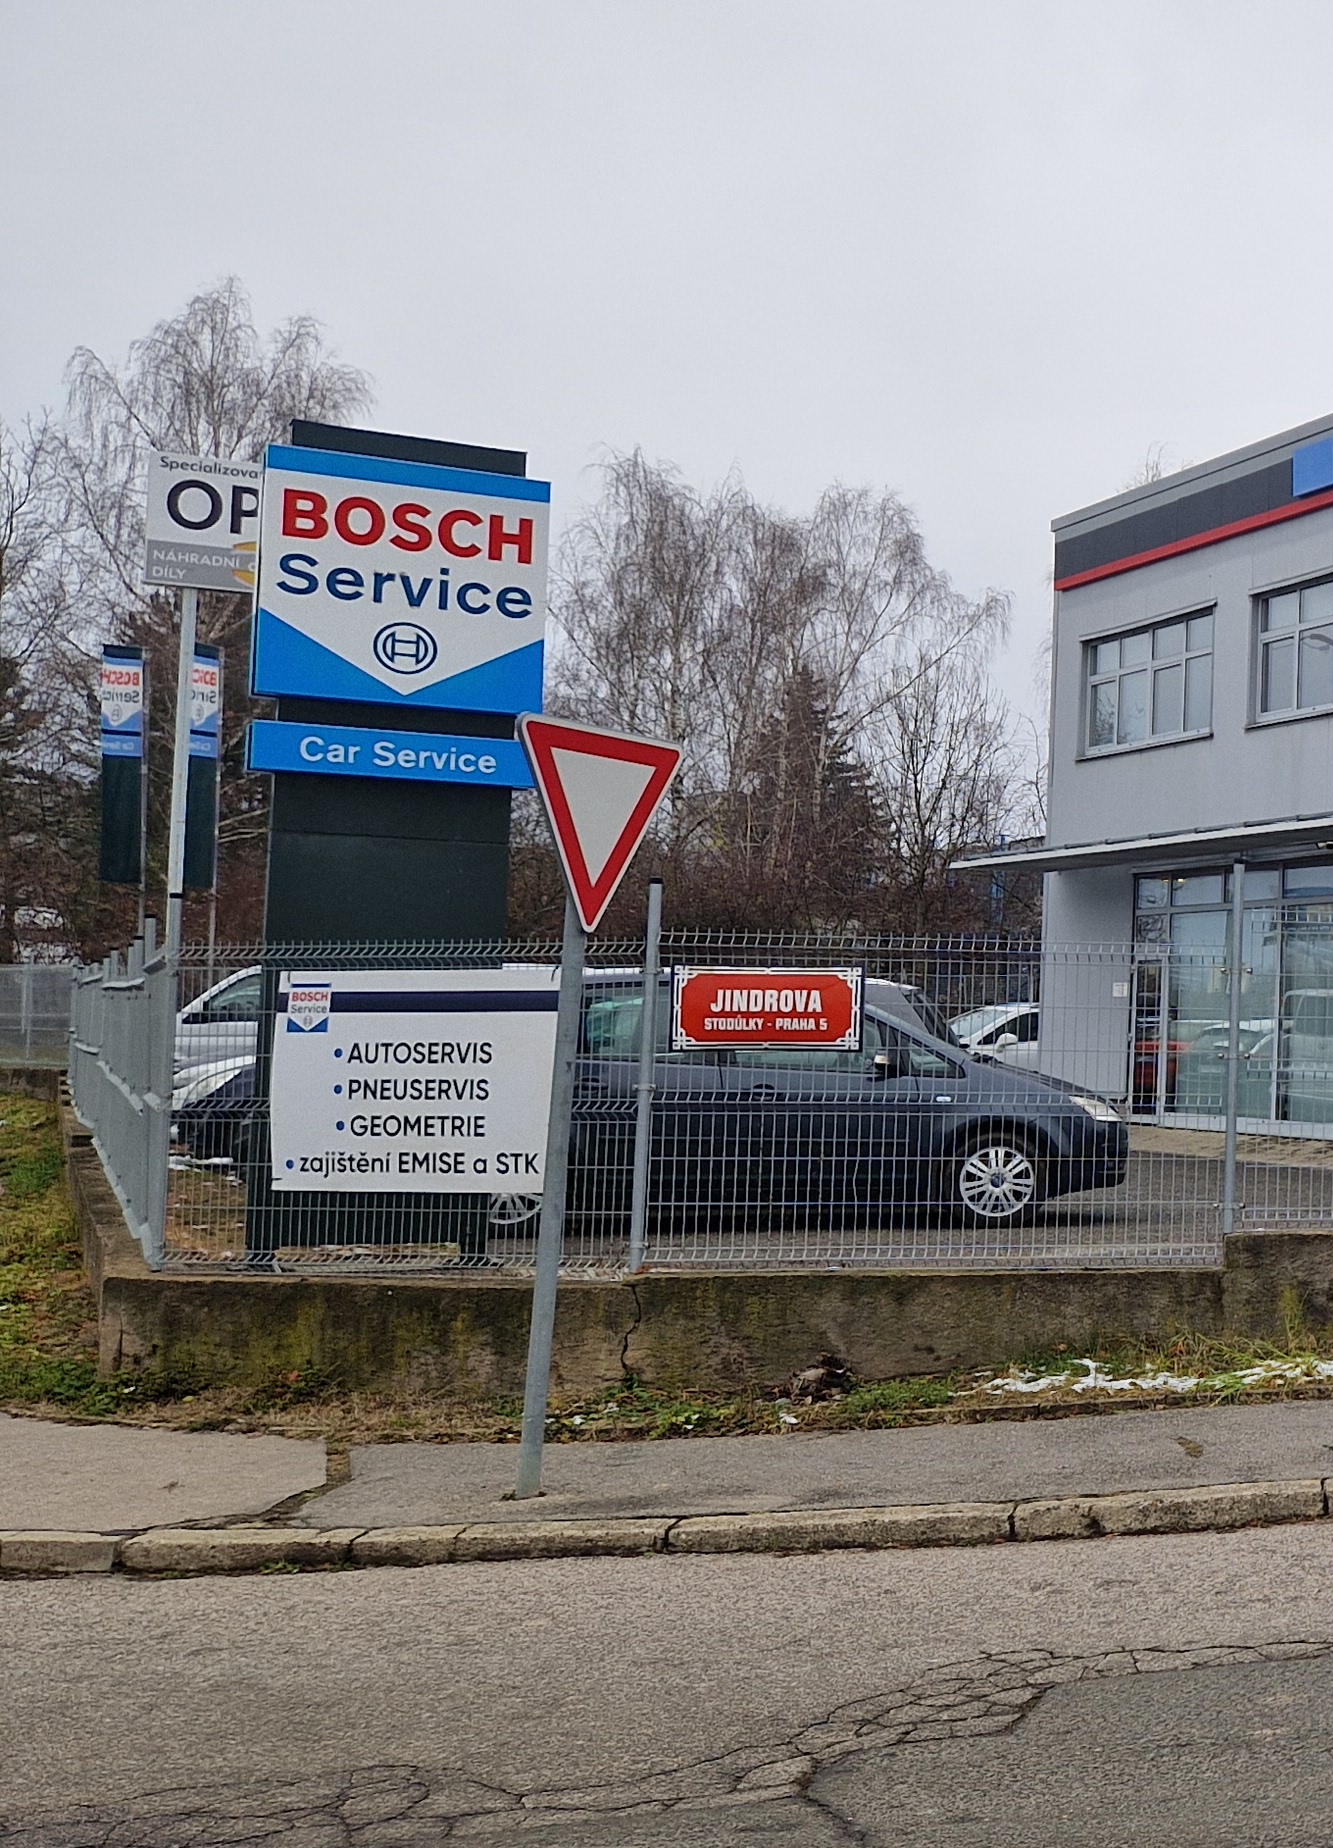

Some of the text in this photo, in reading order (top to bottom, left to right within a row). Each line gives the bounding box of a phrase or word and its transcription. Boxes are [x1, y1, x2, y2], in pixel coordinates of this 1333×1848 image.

[160, 455, 263, 479] Specializova
[167, 479, 259, 534] OP
[281, 488, 534, 565] BOSCH
[153, 546, 240, 568] NÁHRADNÍ
[153, 563, 187, 579] DÍLY
[276, 553, 533, 619] Service
[300, 735, 498, 774] Car Service
[291, 991, 329, 1002] BOSCH
[709, 989, 823, 1013] JINDROVA
[290, 1003, 328, 1014] Service
[704, 1014, 764, 1031] STODŮLKY
[775, 1018, 817, 1031] PRAHA
[819, 1018, 828, 1031] 5
[347, 1042, 493, 1064] AUTOSERVIS
[348, 1079, 489, 1100] PNEUSERVIS
[350, 1115, 486, 1137] GEOMETRIE
[299, 1151, 540, 1178] zajištění EMISE a STK
